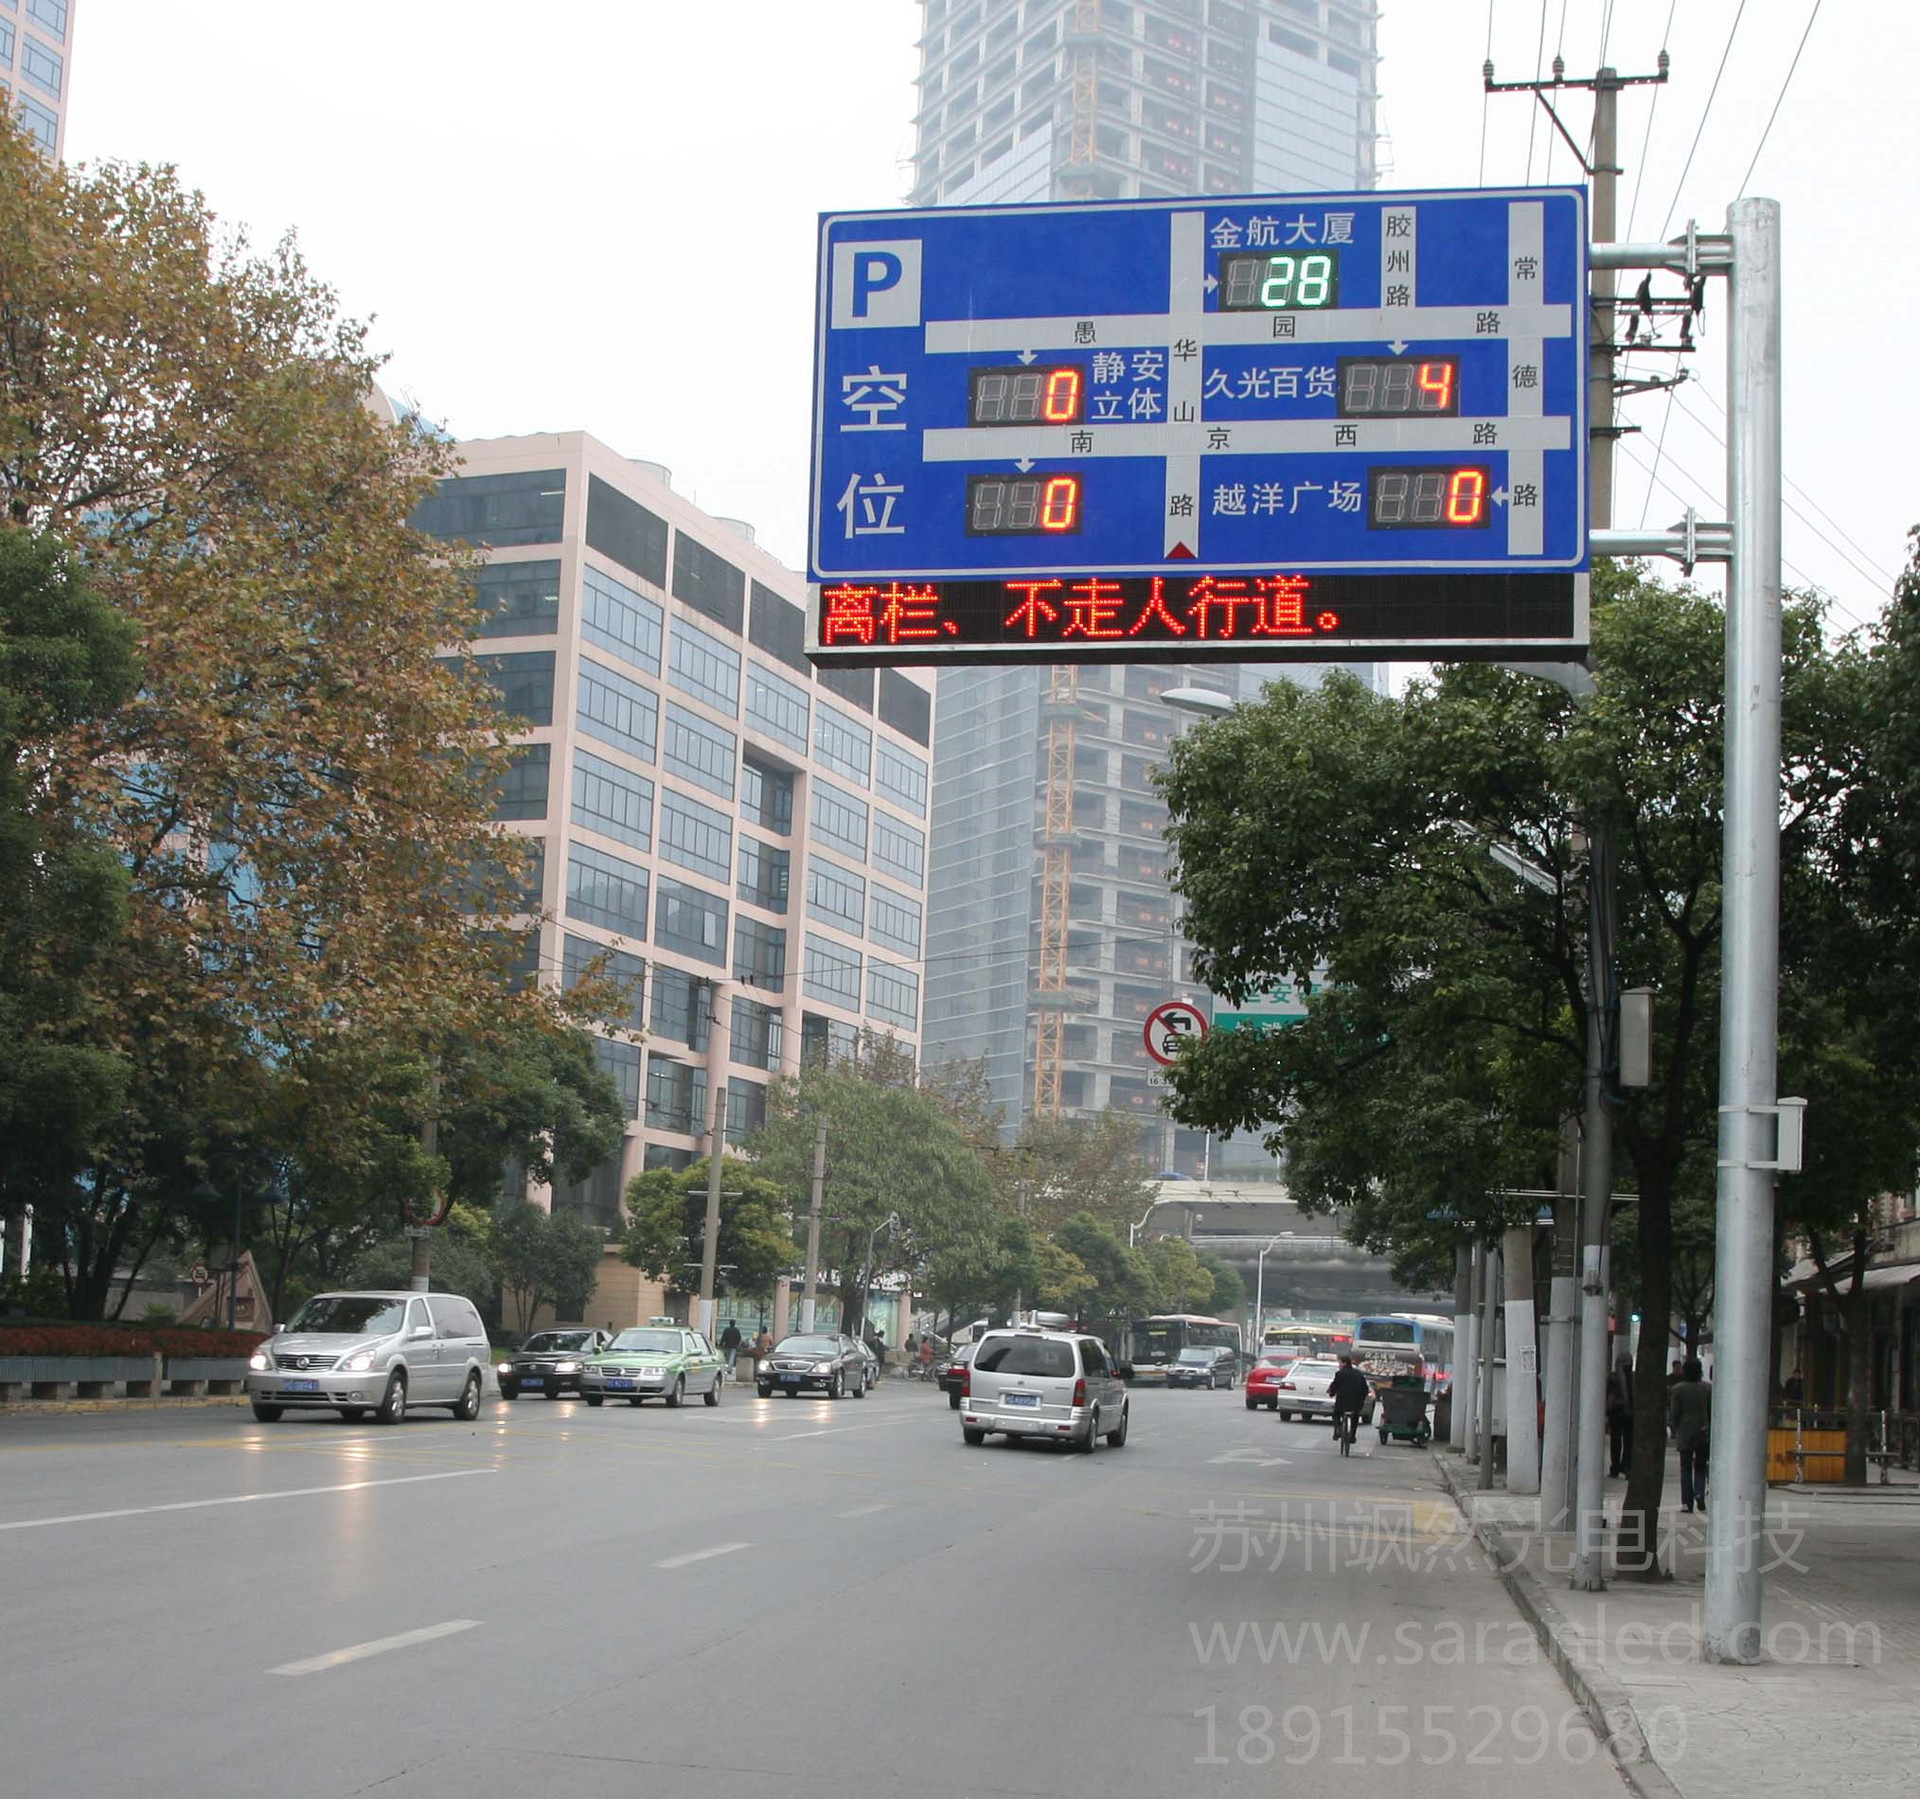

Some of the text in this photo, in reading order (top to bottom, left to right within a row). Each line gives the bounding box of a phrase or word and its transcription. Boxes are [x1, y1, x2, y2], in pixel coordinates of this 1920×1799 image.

[1210, 212, 1355, 249] 金航大厦
[851, 251, 903, 318] P
[1260, 255, 1332, 307] 28
[1385, 214, 1411, 308] 胶州路
[1091, 350, 1164, 385] 静安
[1204, 366, 1337, 399] 久光百货
[1418, 363, 1454, 410] 4
[1044, 370, 1078, 421] 0
[1091, 388, 1162, 420] 立体
[836, 365, 907, 539] 空位
[1043, 478, 1077, 529] 0
[1212, 480, 1362, 516] 越洋广场
[1448, 470, 1483, 522] 0
